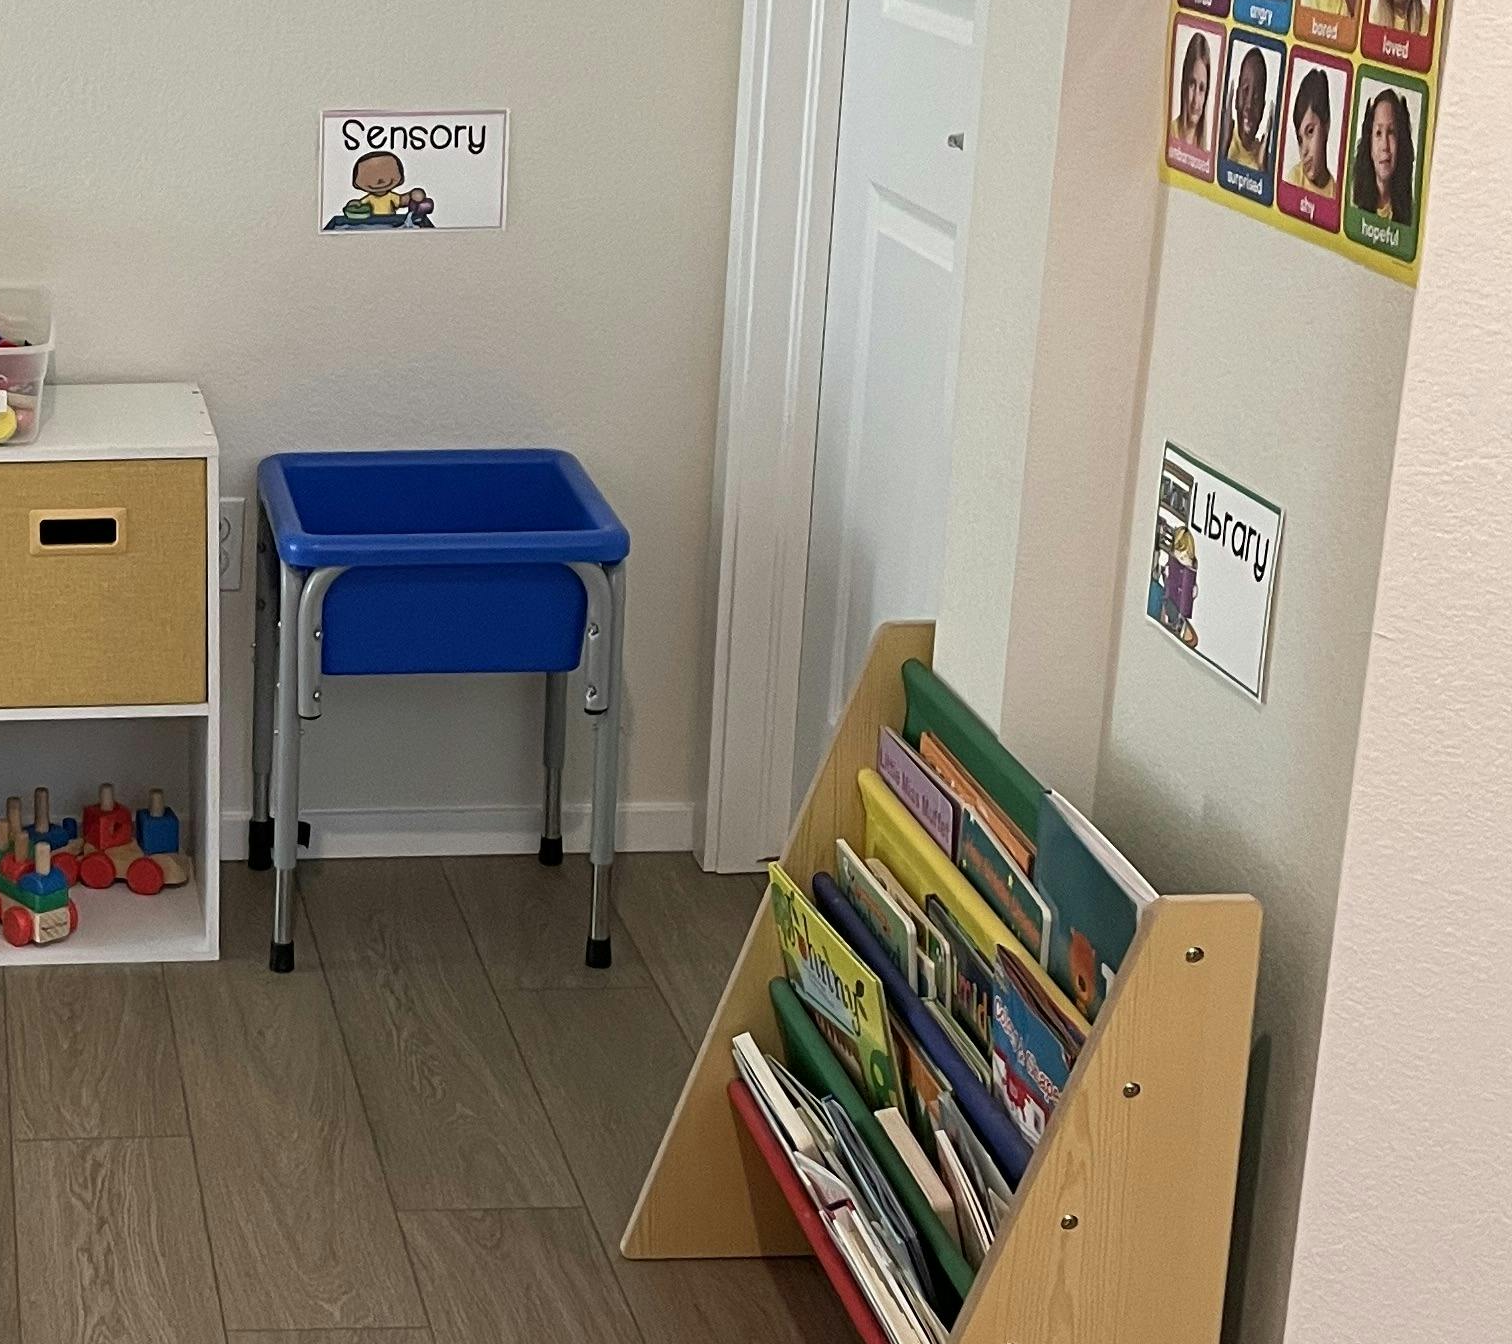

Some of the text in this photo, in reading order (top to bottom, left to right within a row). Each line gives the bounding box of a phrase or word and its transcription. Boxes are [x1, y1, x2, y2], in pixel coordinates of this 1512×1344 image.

[1249, 5, 1273, 26] angry
[1311, 17, 1339, 40] bored
[1382, 33, 1410, 59] loved
[342, 119, 486, 155] Sensory
[1227, 170, 1263, 195] surprised
[1361, 217, 1400, 247] hopeful
[1190, 481, 1271, 583] Library
